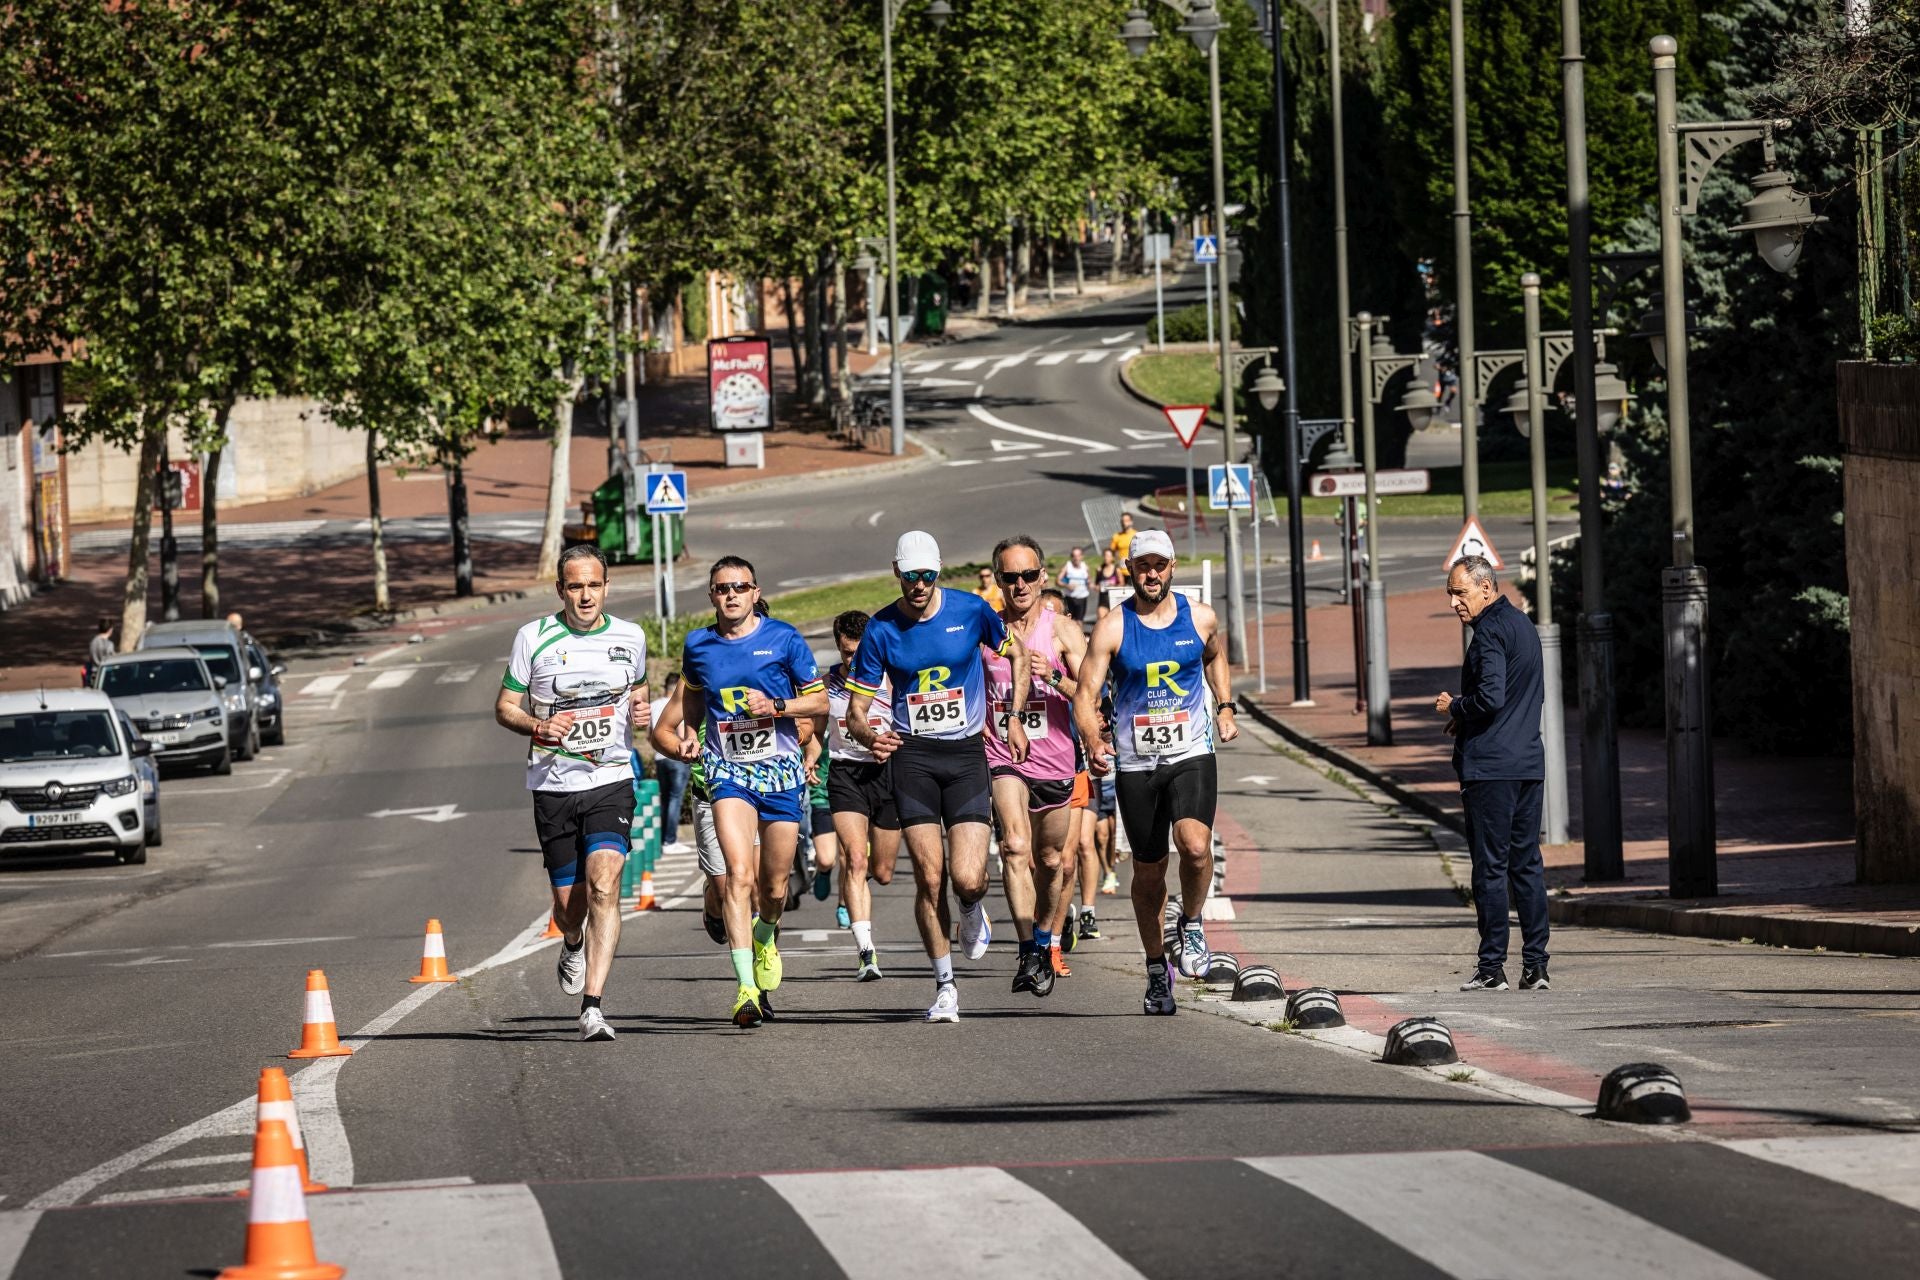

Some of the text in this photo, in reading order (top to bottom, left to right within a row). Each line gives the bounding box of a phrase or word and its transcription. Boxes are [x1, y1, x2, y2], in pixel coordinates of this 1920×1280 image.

[1147, 689, 1167, 699] CLUB
[1147, 696, 1184, 708] MARATÓN
[916, 701, 960, 723] 495
[999, 712, 1042, 731] 48
[568, 718, 611, 742] 205
[1141, 723, 1184, 745] 431
[577, 737, 605, 746] EDUARDO
[727, 730, 771, 752] 192
[735, 748, 764, 756] SANTIAGO
[36, 814, 60, 825] 9297
